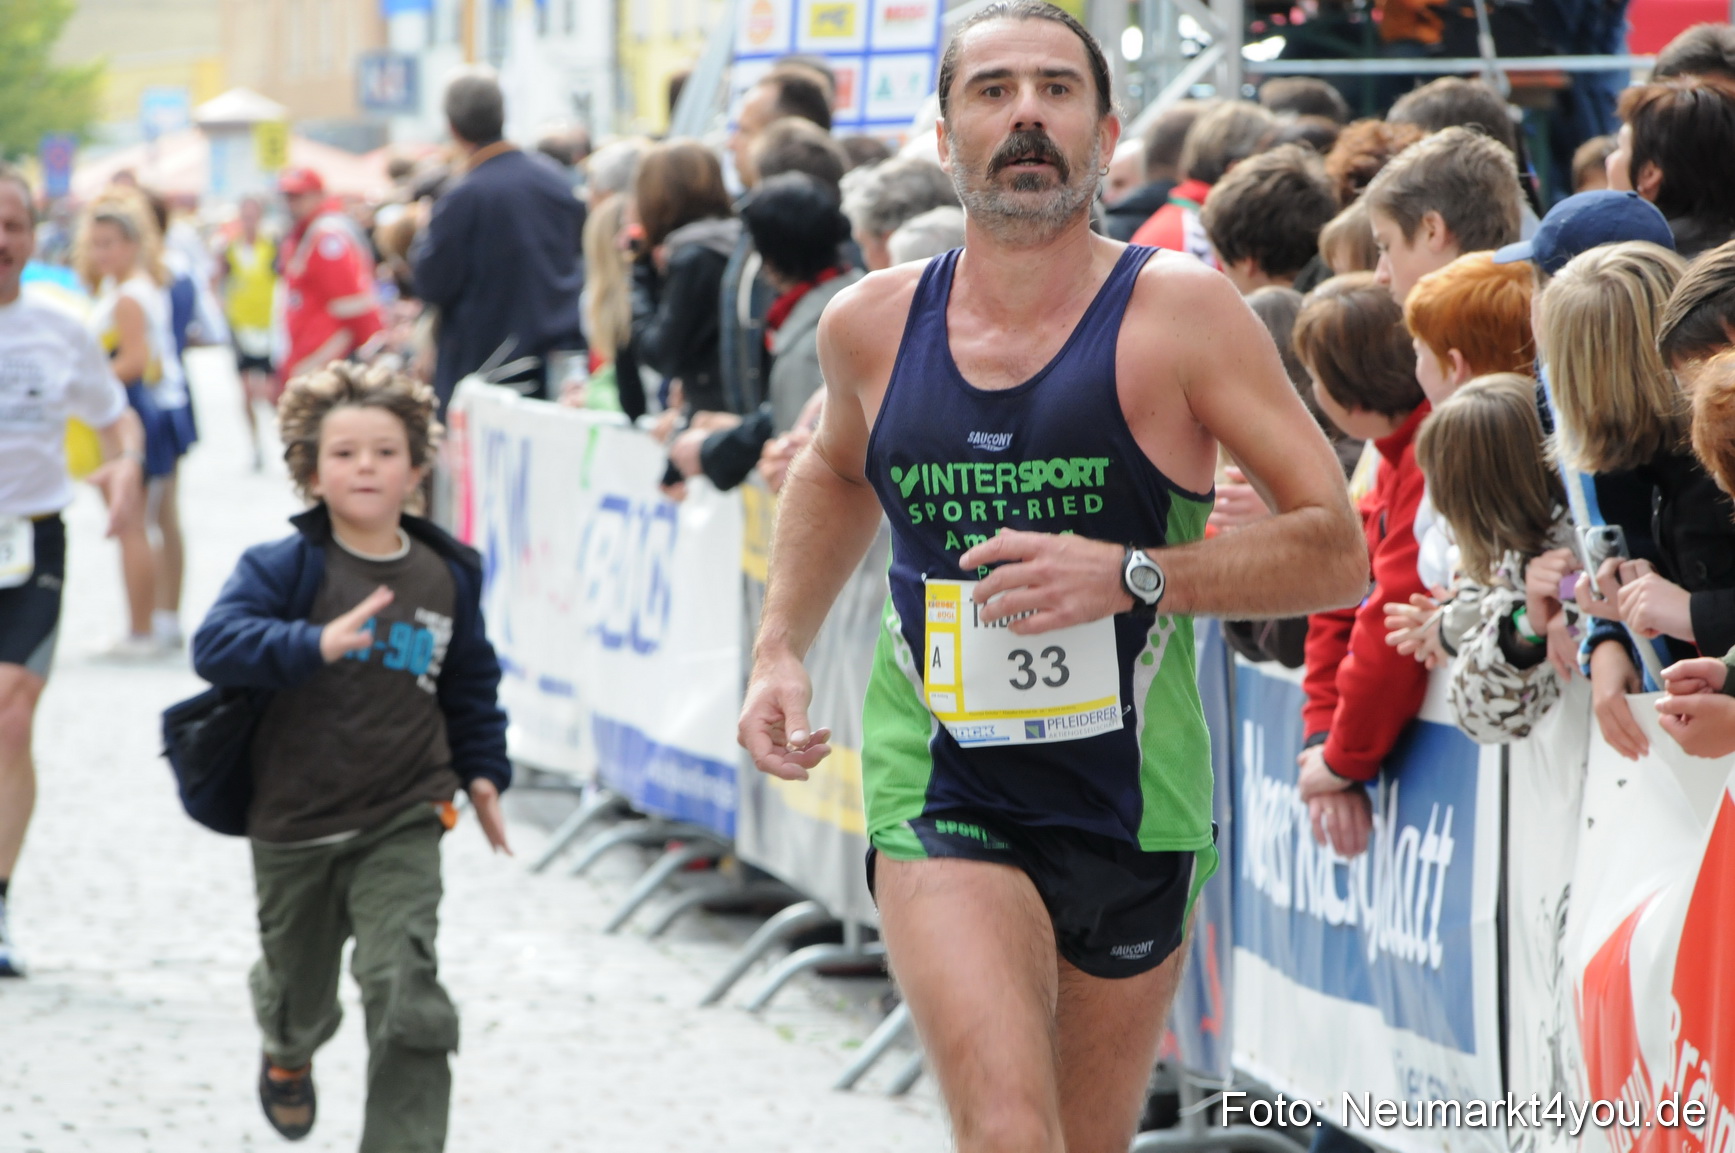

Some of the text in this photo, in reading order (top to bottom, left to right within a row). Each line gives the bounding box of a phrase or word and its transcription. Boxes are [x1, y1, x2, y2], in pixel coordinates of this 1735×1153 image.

[967, 431, 1013, 447] SAUCONY
[921, 457, 1109, 496] INTERSPORT
[908, 494, 1103, 525] SPORT-RIED
[932, 646, 942, 669] A
[1007, 645, 1070, 690] 33
[1047, 706, 1118, 730] PFLEIDERER
[1109, 939, 1155, 956] SAUCONY
